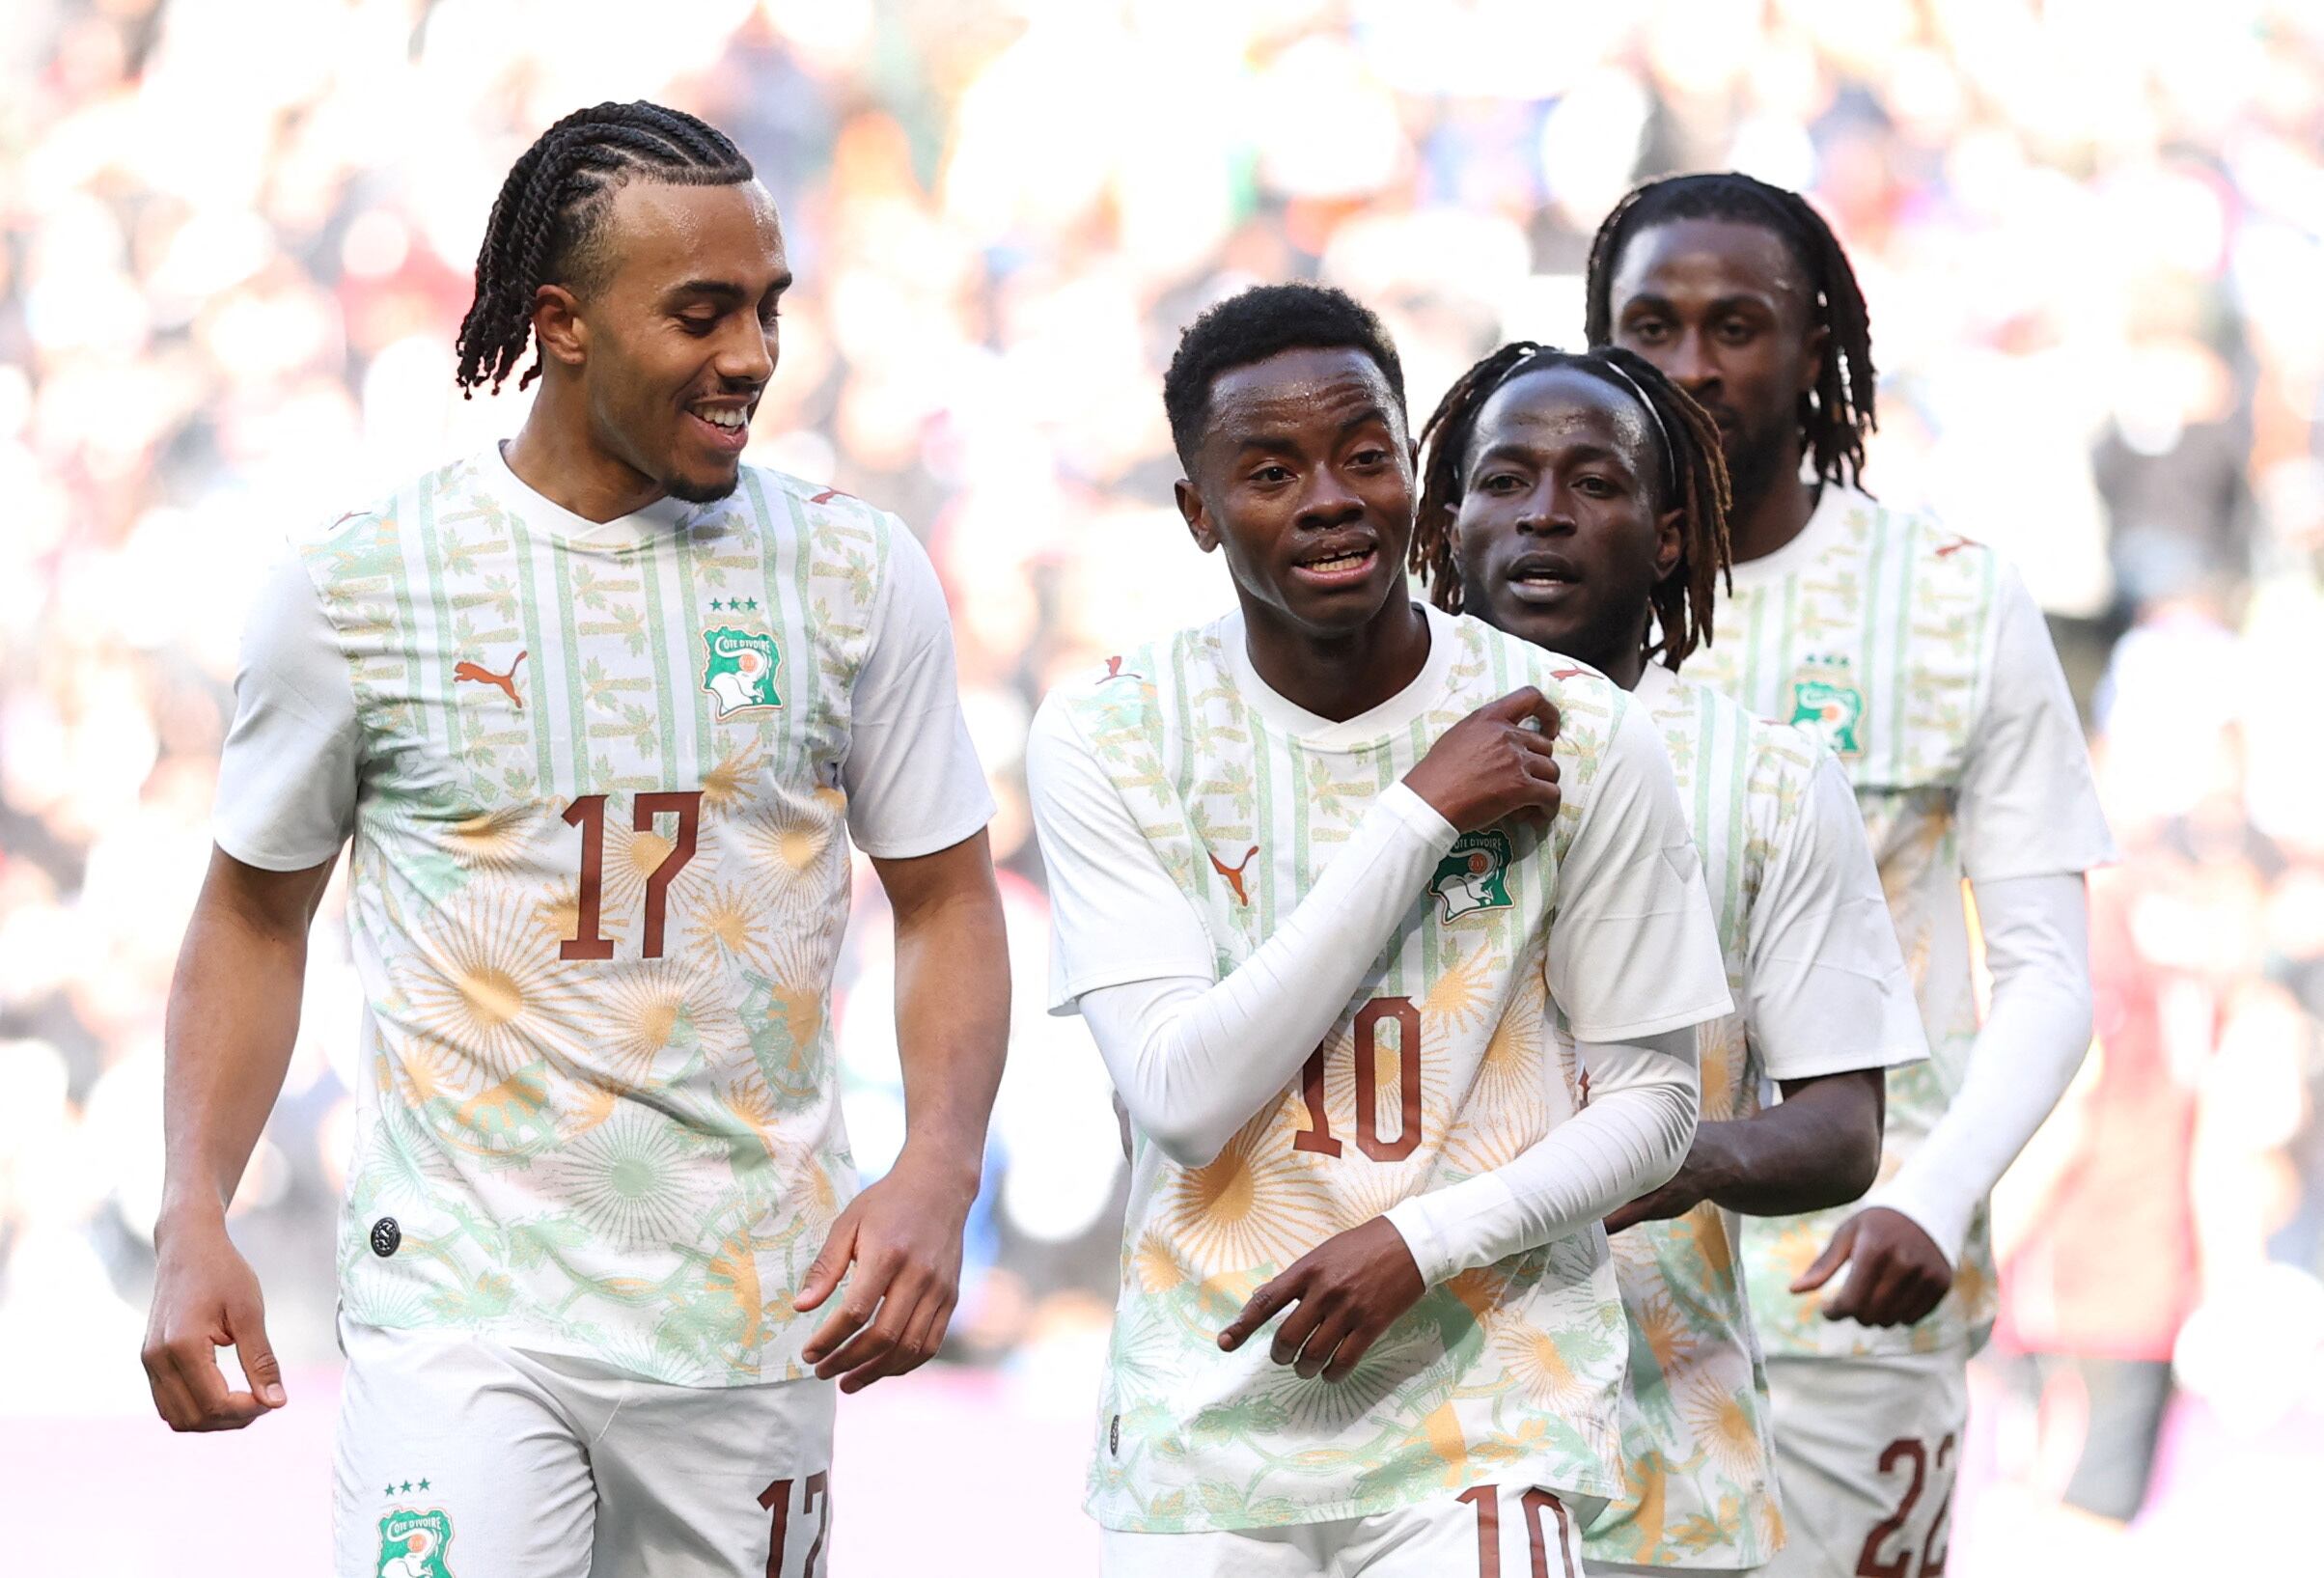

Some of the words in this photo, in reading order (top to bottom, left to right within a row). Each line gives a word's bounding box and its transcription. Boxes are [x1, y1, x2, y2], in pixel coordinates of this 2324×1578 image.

[560, 791, 705, 960] 17
[1293, 996, 1422, 1162] 10
[757, 1469, 827, 1578] 17
